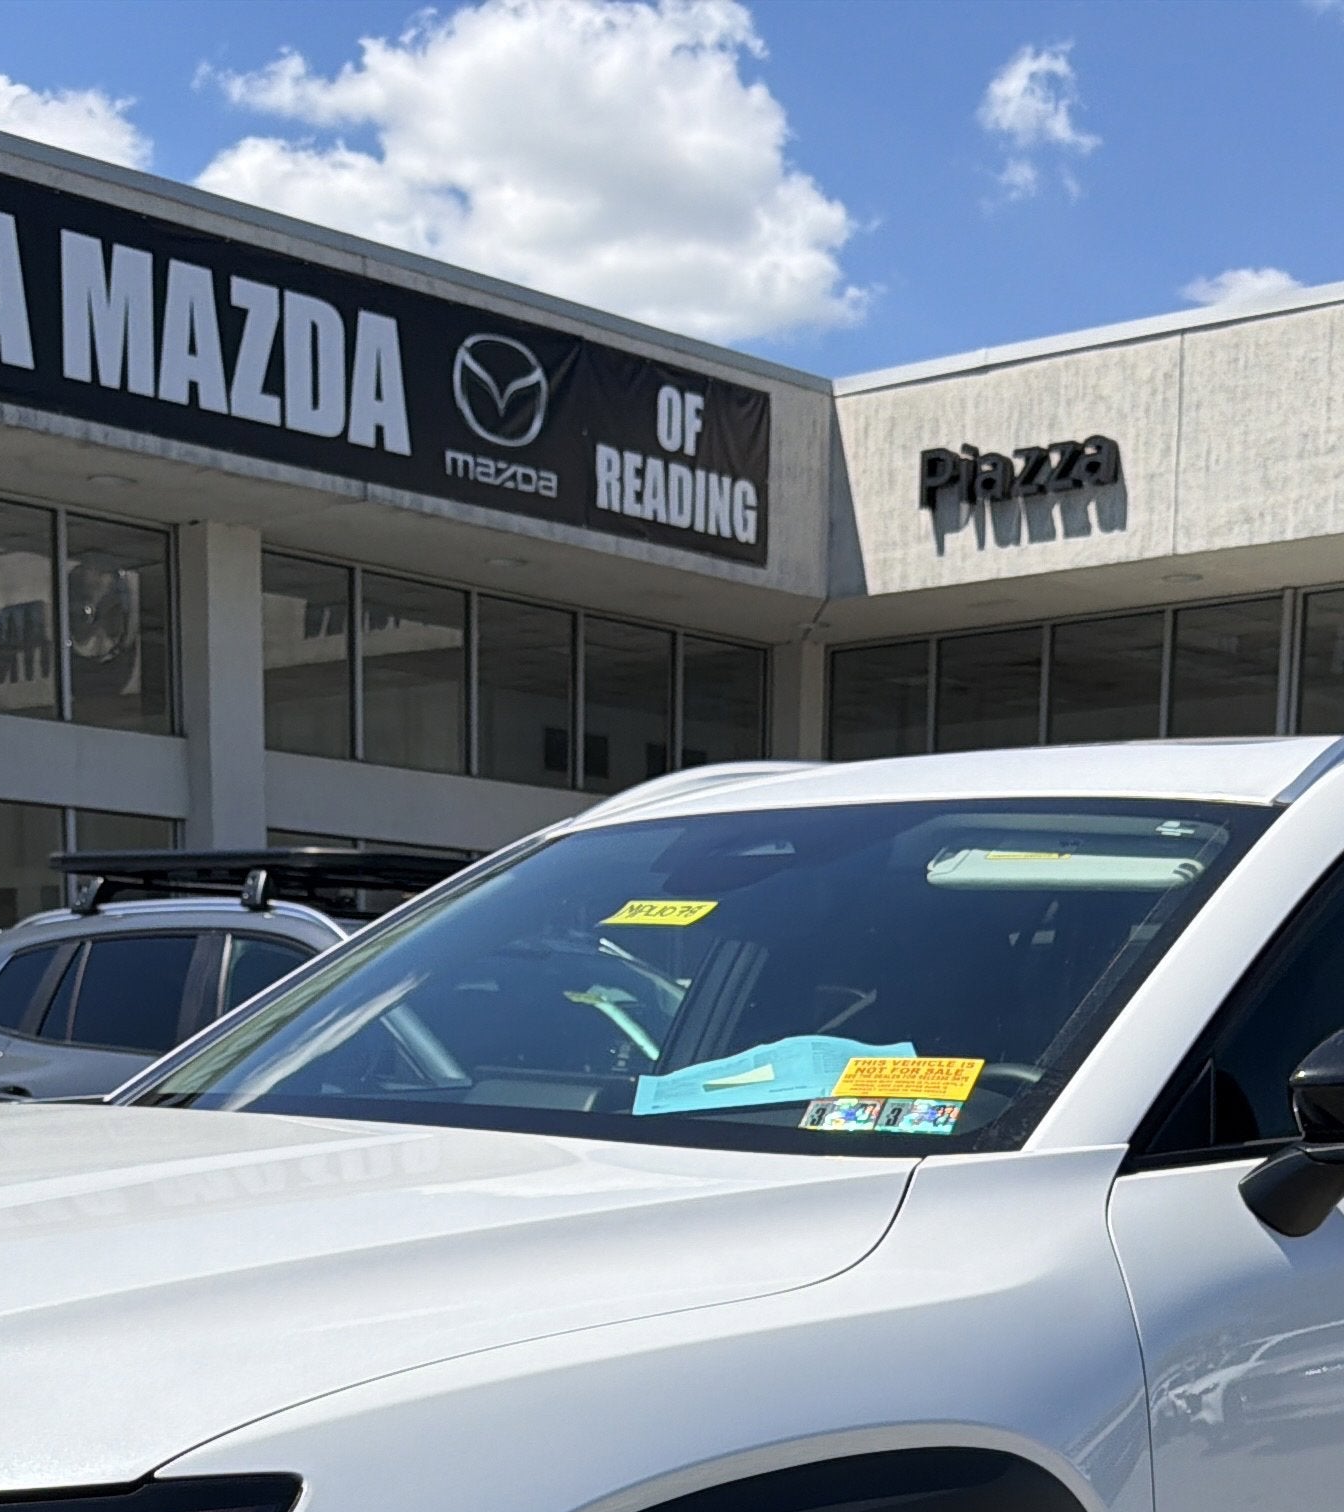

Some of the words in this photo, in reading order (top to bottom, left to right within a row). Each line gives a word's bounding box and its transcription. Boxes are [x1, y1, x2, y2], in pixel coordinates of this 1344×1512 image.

[60, 228, 411, 456] MAZDA
[656, 385, 705, 456] OF
[444, 449, 558, 498] mazda
[595, 443, 757, 545] READING
[919, 434, 1120, 510] Piazza
[853, 1059, 888, 1068] THIS
[892, 1059, 957, 1068] VEHICLE
[960, 1061, 977, 1069] IS
[855, 1066, 885, 1075] NOT
[890, 1067, 920, 1075] FOR
[924, 1068, 965, 1077] SALE
[811, 1107, 826, 1127] 3
[885, 1107, 901, 1127] 3
